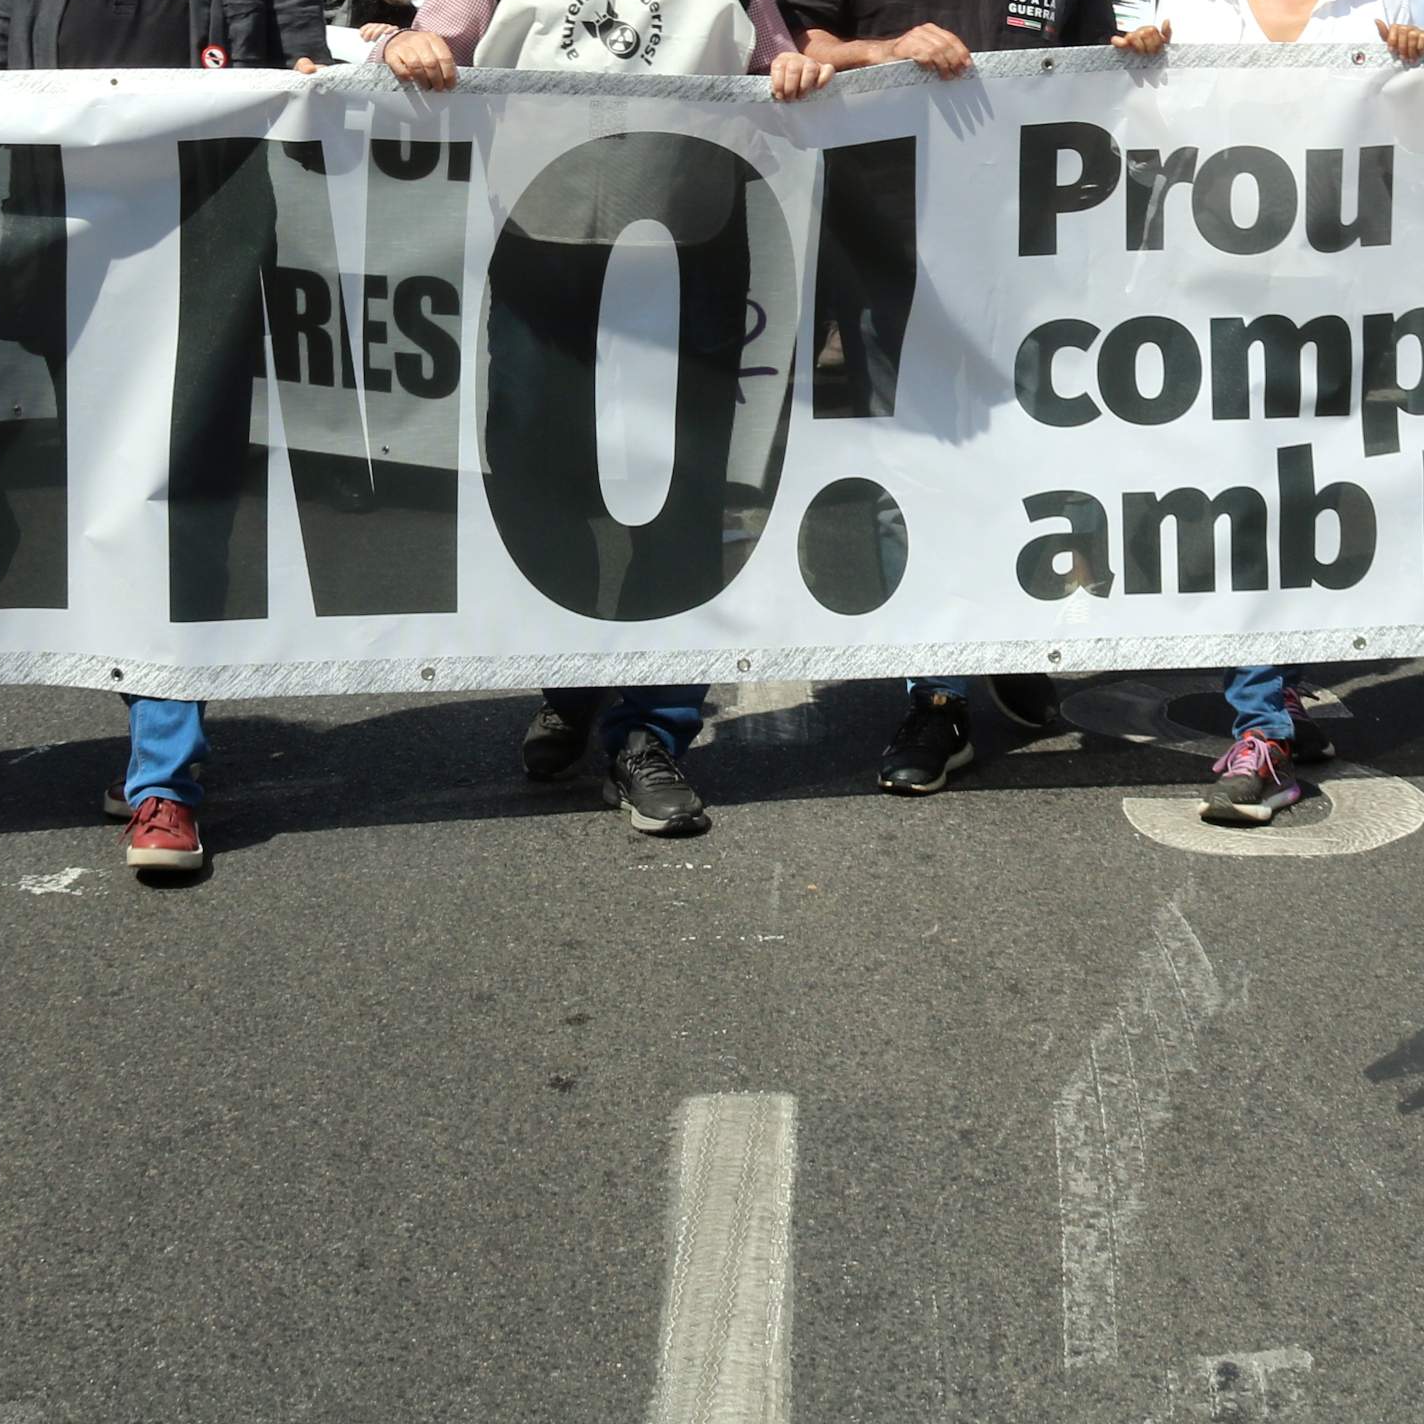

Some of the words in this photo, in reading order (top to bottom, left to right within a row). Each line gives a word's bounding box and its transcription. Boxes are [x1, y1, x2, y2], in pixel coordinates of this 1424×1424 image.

[1008, 2, 1056, 22] GUERRA
[1017, 120, 1394, 257] Prou
[169, 131, 918, 623] NO!
[1016, 444, 1376, 601] amb
